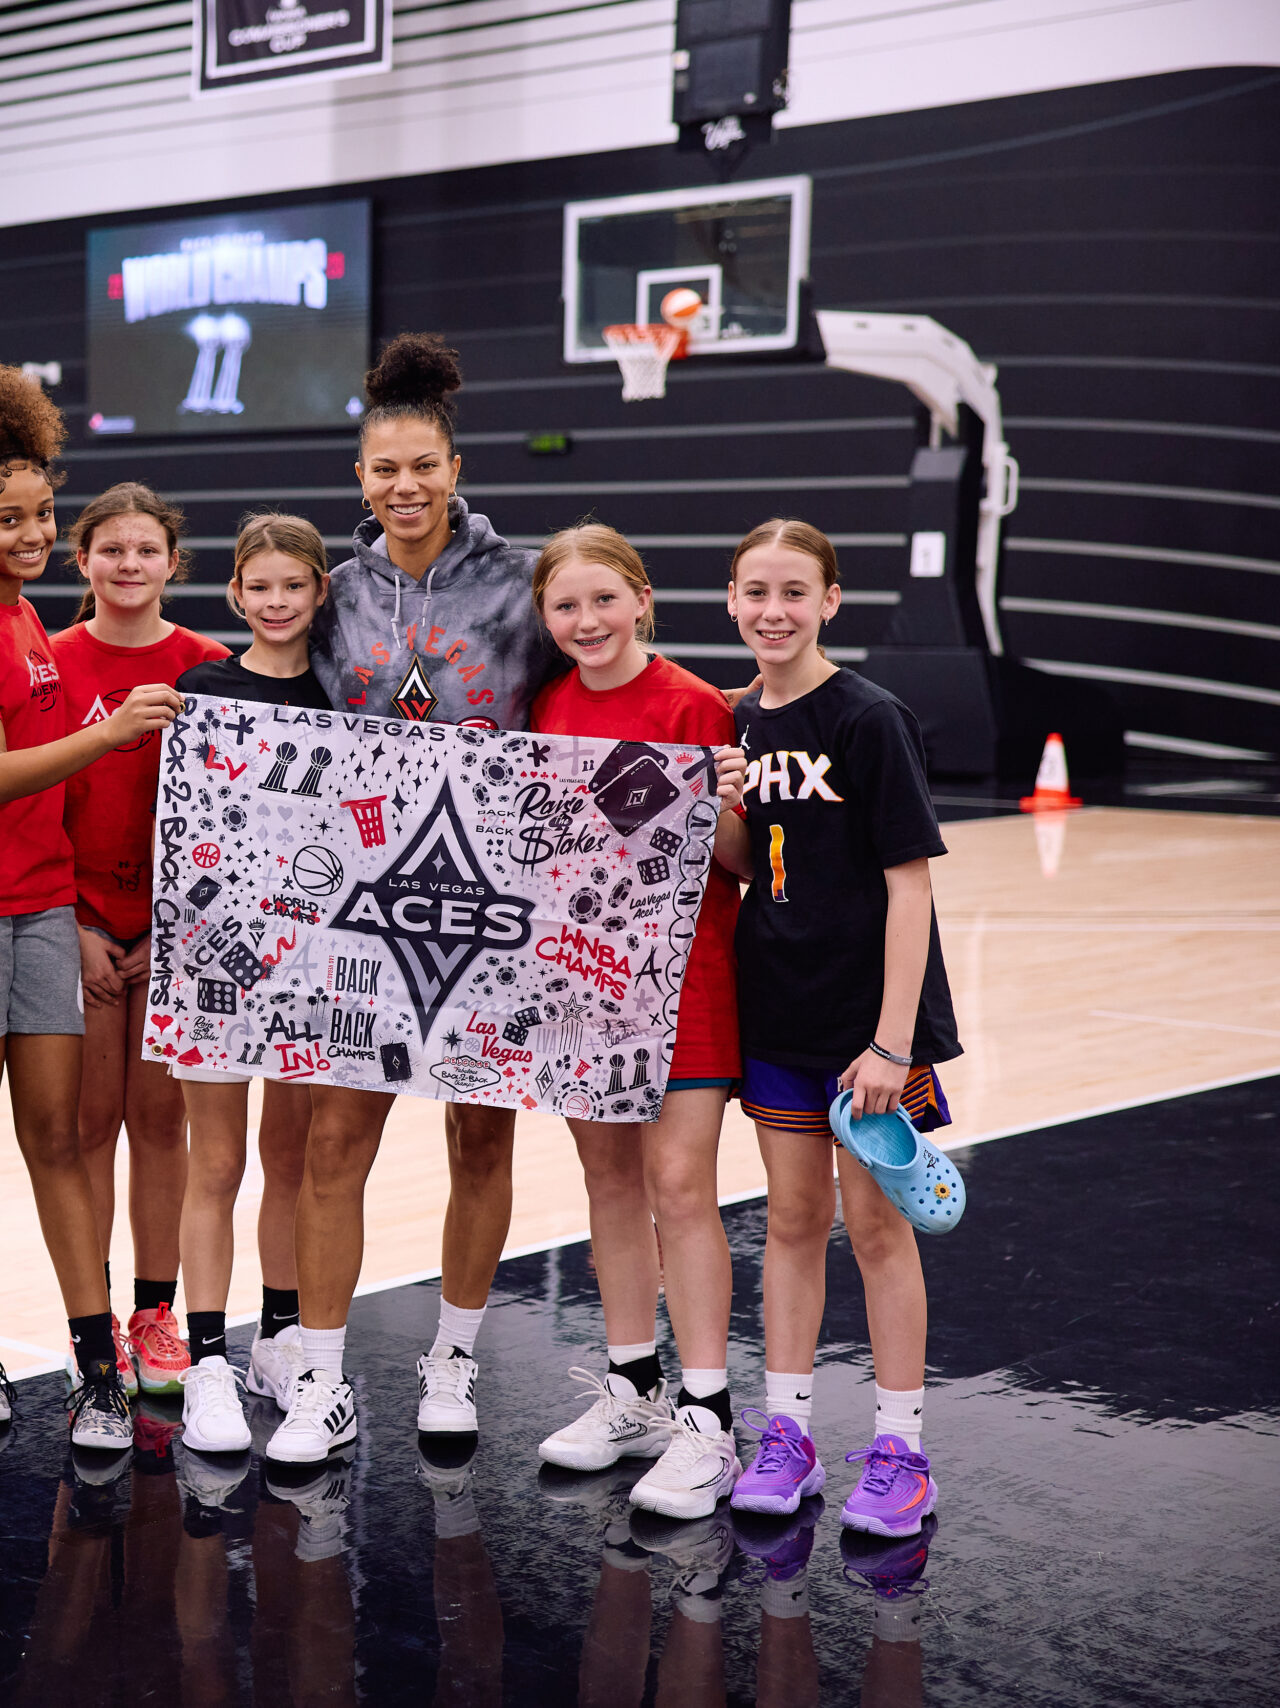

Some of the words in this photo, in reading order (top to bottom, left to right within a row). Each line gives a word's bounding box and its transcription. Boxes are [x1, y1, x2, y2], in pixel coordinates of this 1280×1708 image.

[24, 654, 60, 687] AES
[347, 642, 391, 706] LAS
[406, 623, 495, 705] VEGAS
[273, 707, 332, 729] LAS
[343, 717, 446, 742] VEGAS
[742, 750, 845, 804] PHX
[513, 782, 589, 825] Raise
[553, 813, 570, 825] the
[475, 825, 514, 836] BACK
[768, 824, 789, 903] 1
[388, 878, 421, 890] LAS
[429, 883, 486, 896] VEGAS
[629, 894, 648, 910] Las
[647, 890, 670, 908] Vegas
[183, 908, 196, 924] LVA
[263, 903, 316, 926] CHAMPS
[272, 894, 319, 913] WORLD
[345, 890, 523, 941] ACES
[632, 907, 654, 921] Aces
[183, 915, 243, 981] ACES
[195, 922, 217, 944] VEGAS
[150, 898, 181, 1007] CHAMPS
[561, 925, 632, 979] WNBA
[334, 956, 382, 996] BACK
[535, 936, 628, 1001] CHAMPS
[264, 1011, 323, 1043] ALL
[329, 1008, 377, 1049] BACK
[465, 1010, 497, 1036] Las
[273, 1041, 331, 1073] IN!
[326, 1044, 376, 1061] CHAMPS
[444, 1056, 491, 1069] WELCOME
[480, 1035, 533, 1067] Vegas
[441, 1070, 488, 1084] BACK-2-BACK
